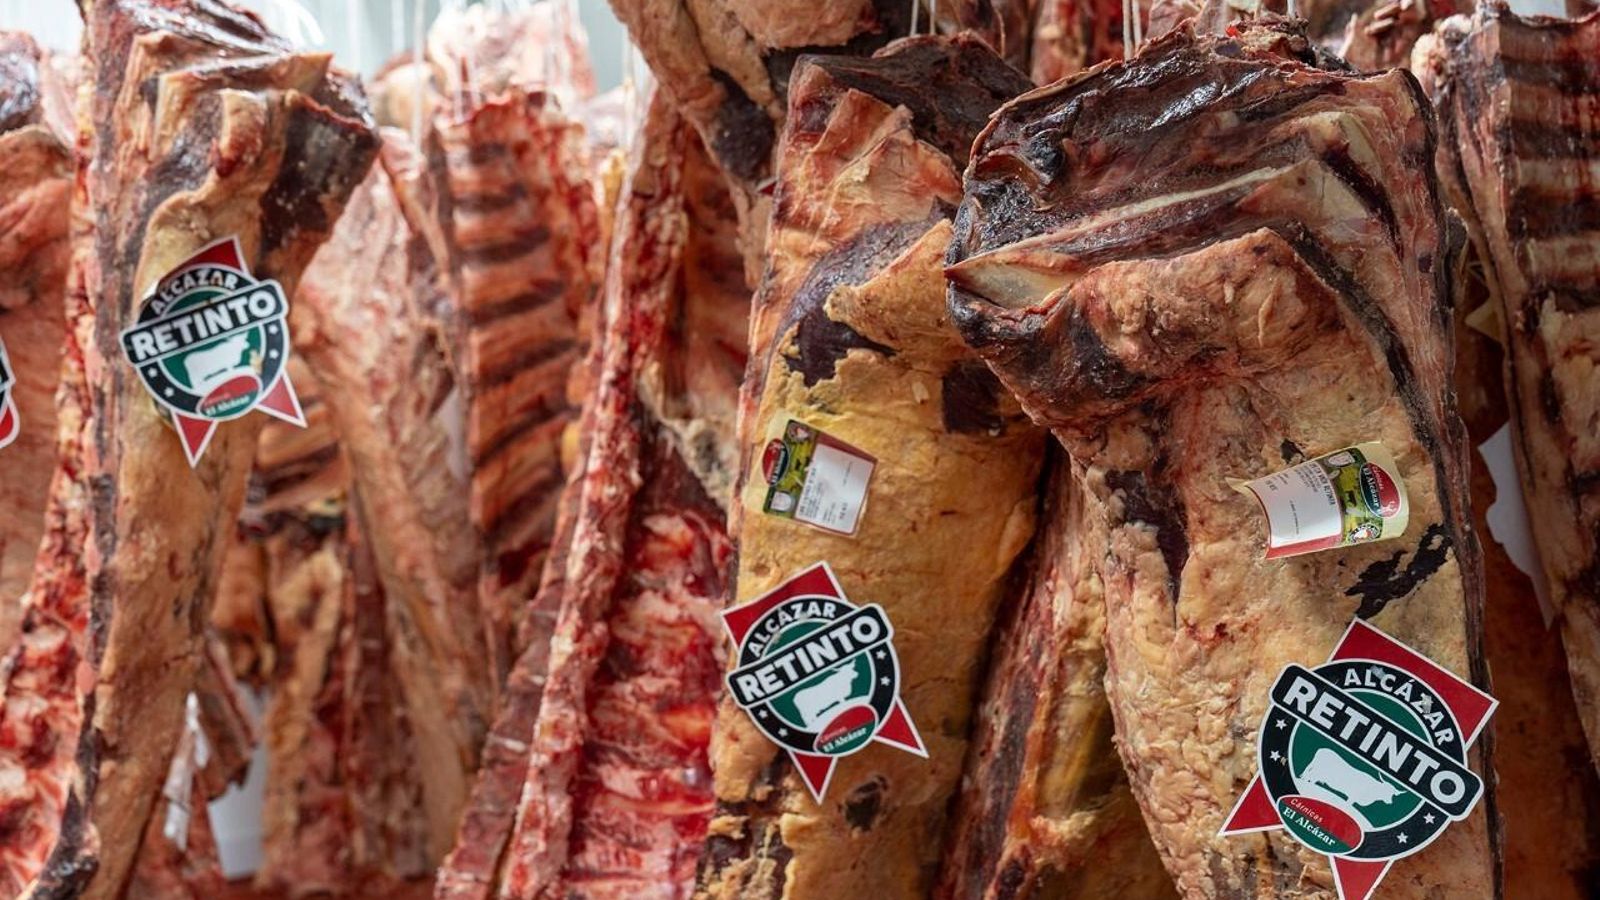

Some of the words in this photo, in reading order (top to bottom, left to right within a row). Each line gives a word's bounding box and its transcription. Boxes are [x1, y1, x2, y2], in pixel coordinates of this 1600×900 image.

[130, 290, 276, 361] RETINTO
[735, 615, 880, 702] RETINTO
[1283, 676, 1466, 804] RETINTO
[1344, 668, 1455, 746] ALCÁZAR
[1283, 807, 1296, 820] El
[1295, 815, 1336, 847] Alcázar
[1290, 798, 1324, 823] Cárnicas
